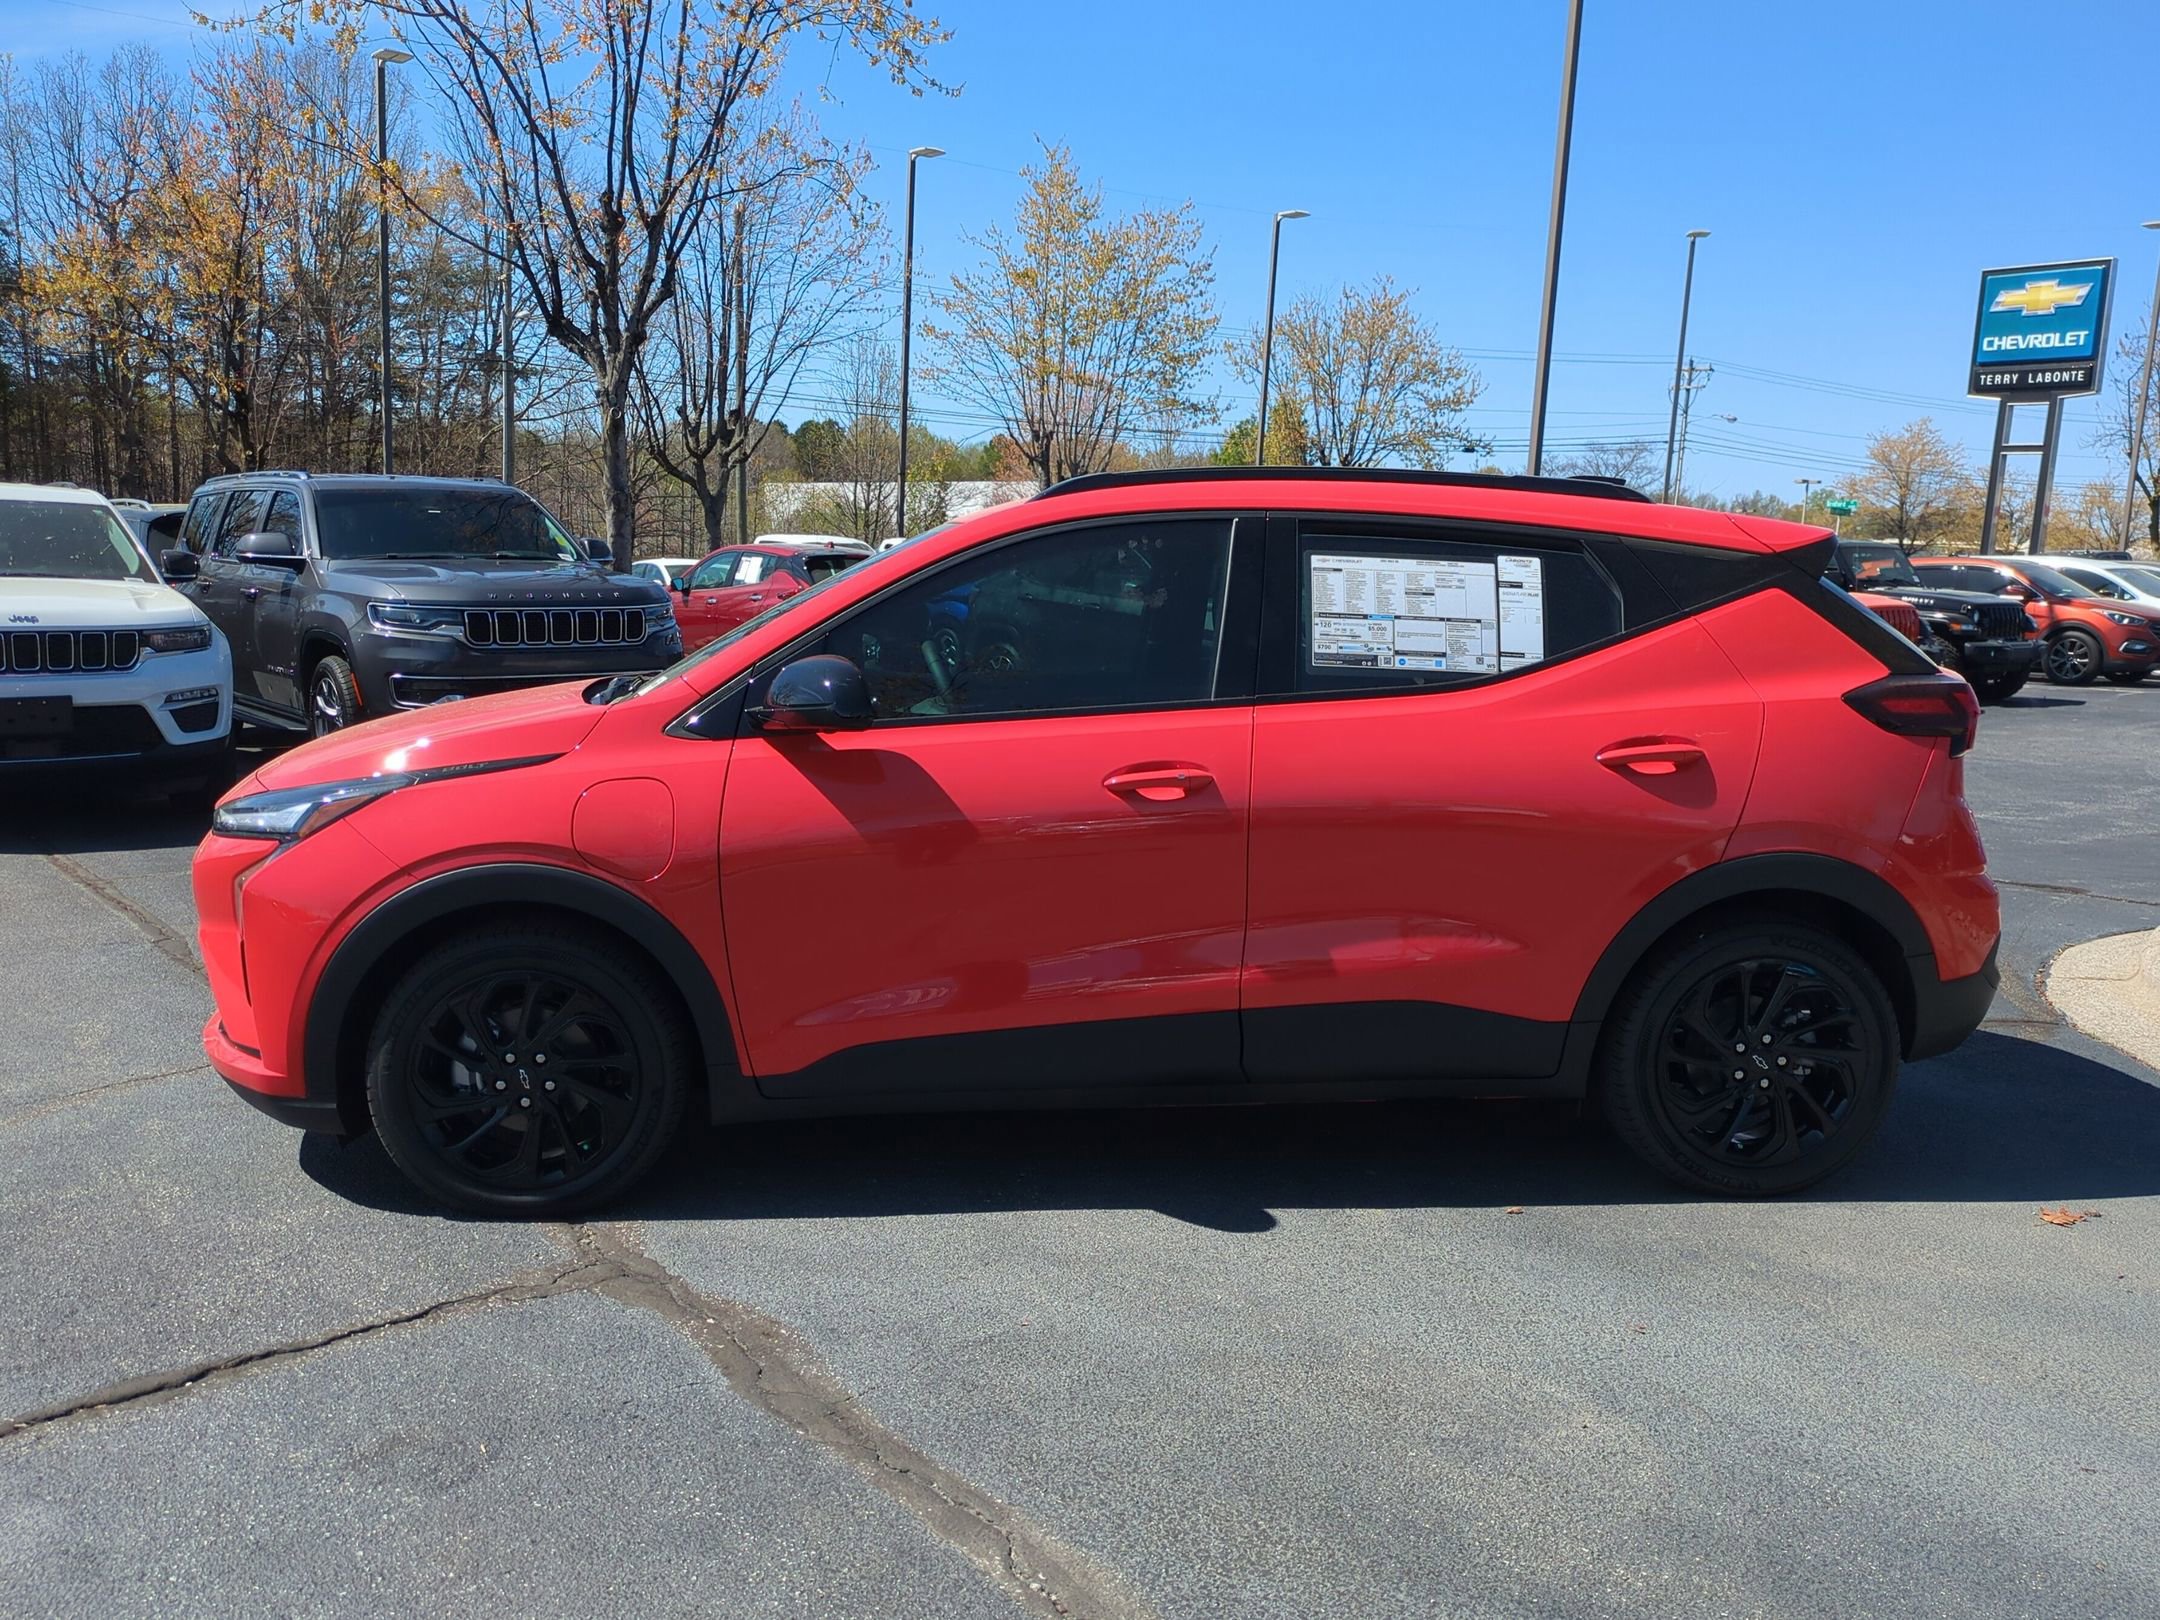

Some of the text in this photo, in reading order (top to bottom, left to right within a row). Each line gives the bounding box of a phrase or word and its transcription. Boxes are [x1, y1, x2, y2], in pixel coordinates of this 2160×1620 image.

[1982, 331, 2089, 351] CHEVROLET
[1980, 370, 2085, 385] TERRY LABONTE
[8, 614, 40, 625] Jeep
